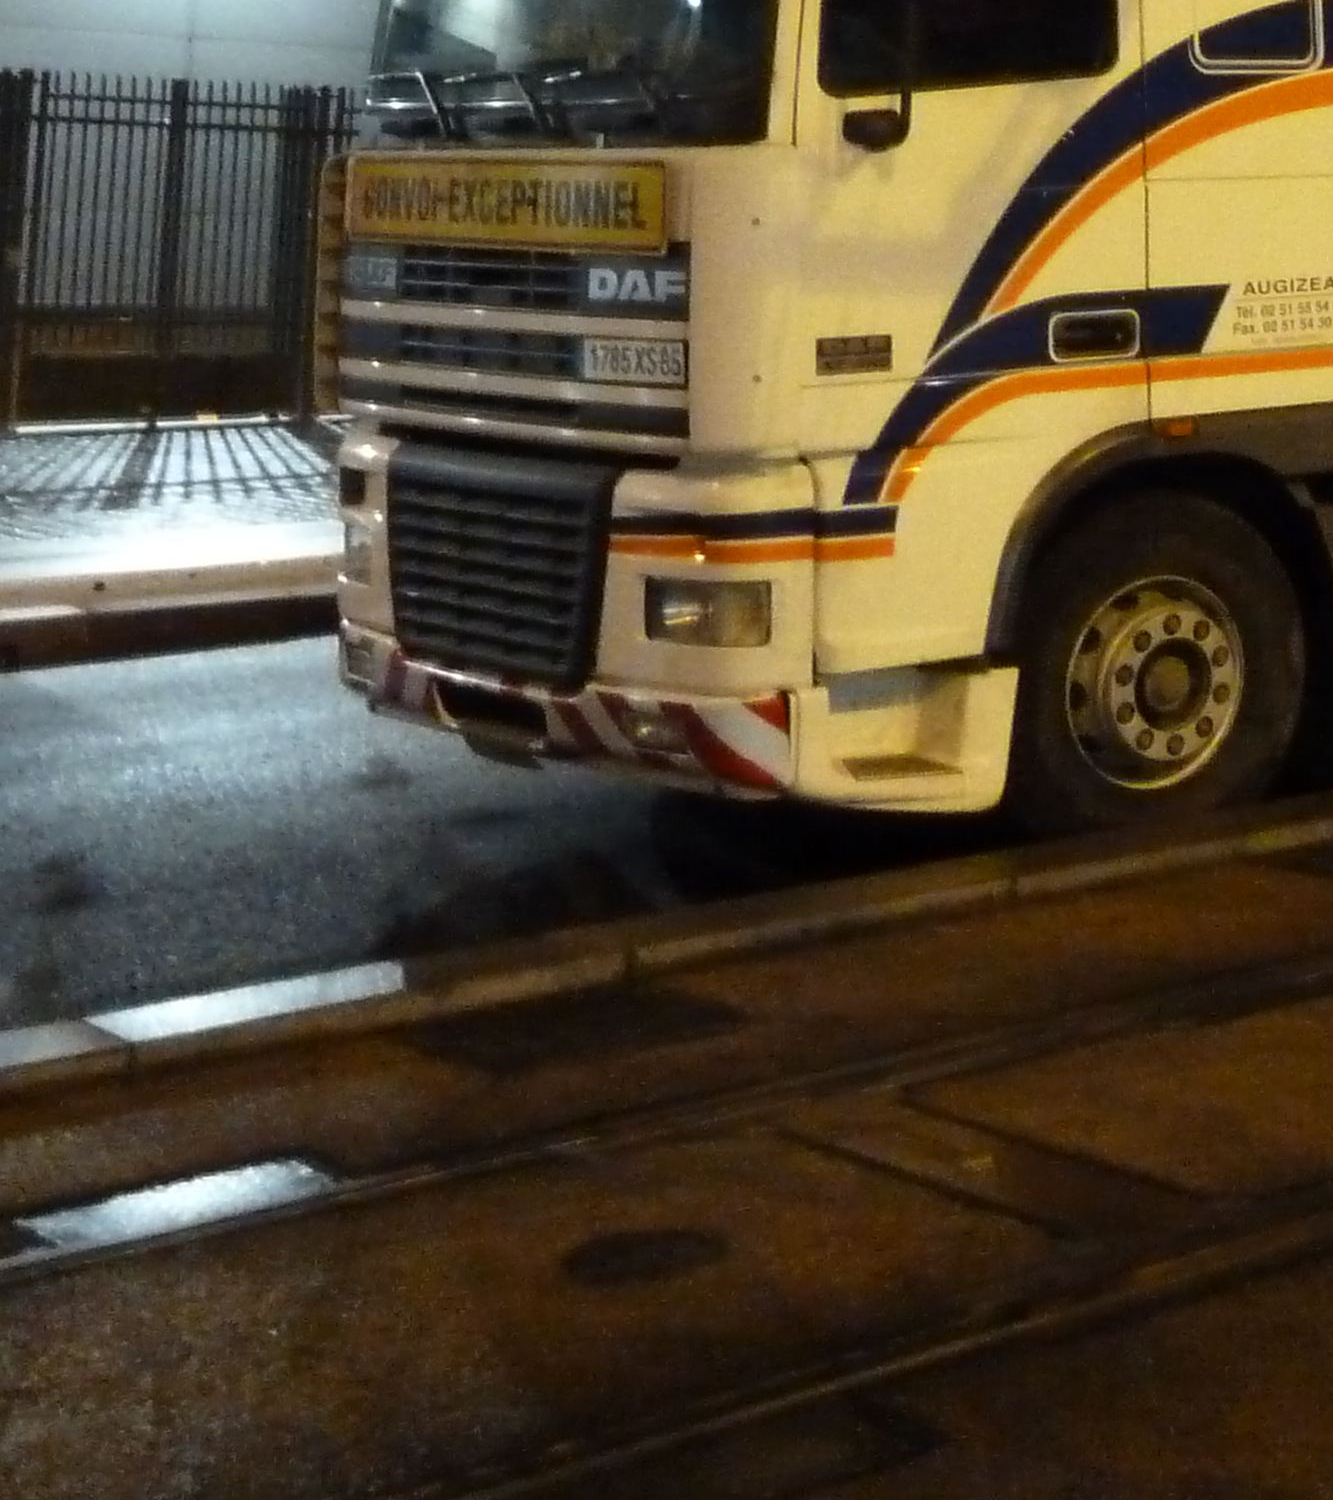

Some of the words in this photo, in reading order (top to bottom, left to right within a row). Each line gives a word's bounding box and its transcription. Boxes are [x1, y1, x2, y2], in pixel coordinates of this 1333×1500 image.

[448, 177, 648, 231] EXCEPTIONNEL
[587, 267, 687, 301] DAF
[1260, 304, 1276, 317] 02
[1279, 303, 1293, 316] 51
[1262, 320, 1278, 333] 02
[1281, 319, 1295, 331] 51
